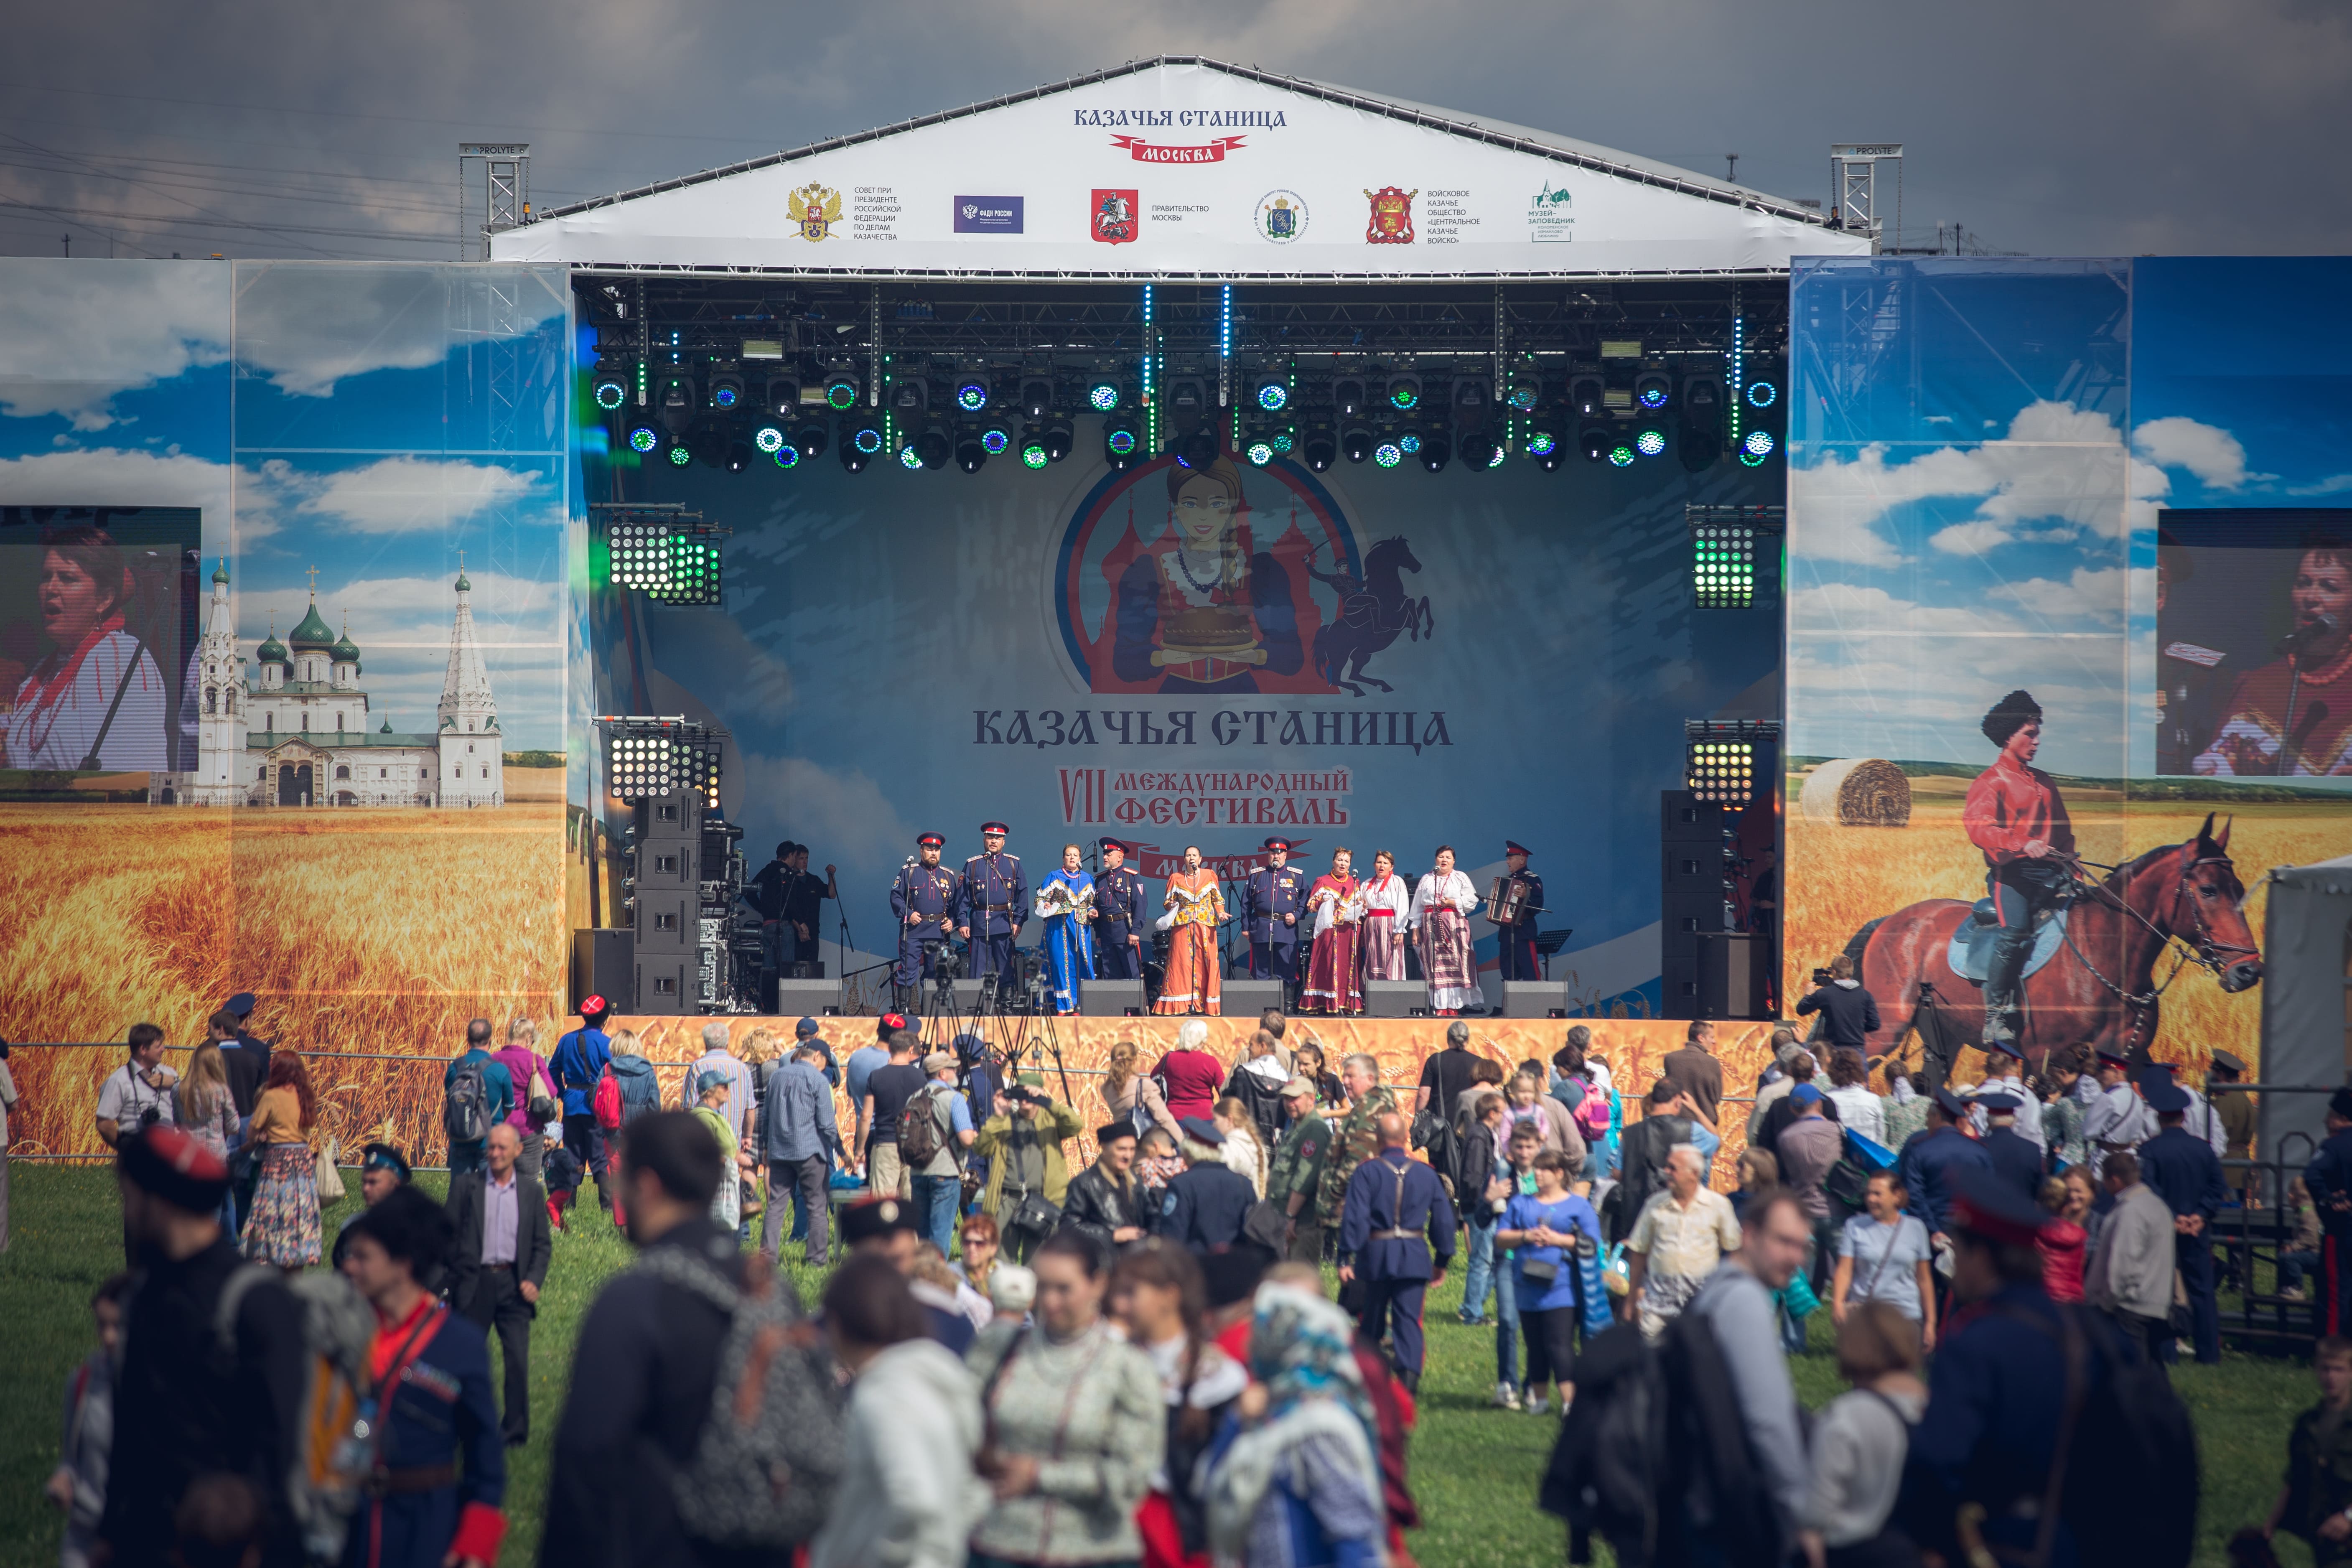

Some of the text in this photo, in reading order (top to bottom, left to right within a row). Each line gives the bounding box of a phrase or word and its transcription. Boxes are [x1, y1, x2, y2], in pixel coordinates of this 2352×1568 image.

[1074, 109, 1287, 131] КАЗАЧЬЯ СТАНИЦА
[1142, 148, 1214, 162] МОСКВА
[973, 710, 1453, 756] КАЗАЧЬЯ СТАНИЦА
[1059, 769, 1105, 822] VII
[1114, 768, 1349, 797] МЕЖДУНАРОДНЫЙ
[1115, 797, 1347, 824] ФЕСТИВАЛЬ
